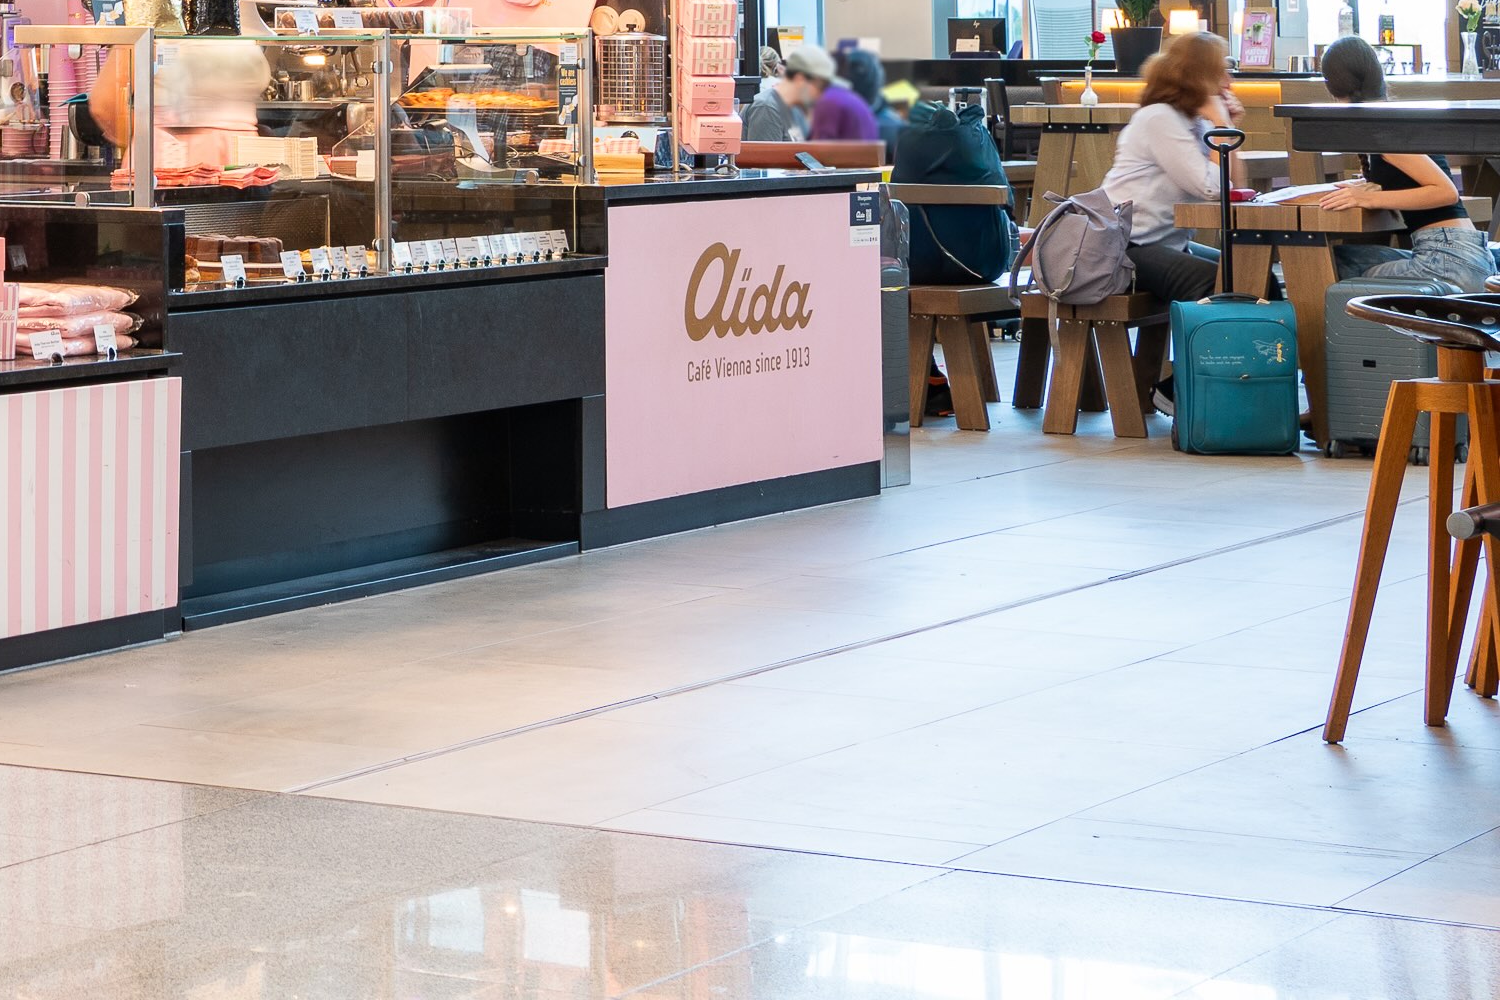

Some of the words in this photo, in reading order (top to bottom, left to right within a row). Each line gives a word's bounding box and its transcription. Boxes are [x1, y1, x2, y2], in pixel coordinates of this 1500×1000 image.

[1245, 54, 1266, 63] LATTE
[687, 358, 711, 382] Café
[715, 356, 751, 378] Vienna
[756, 352, 781, 373] since
[786, 346, 810, 369] 1913
